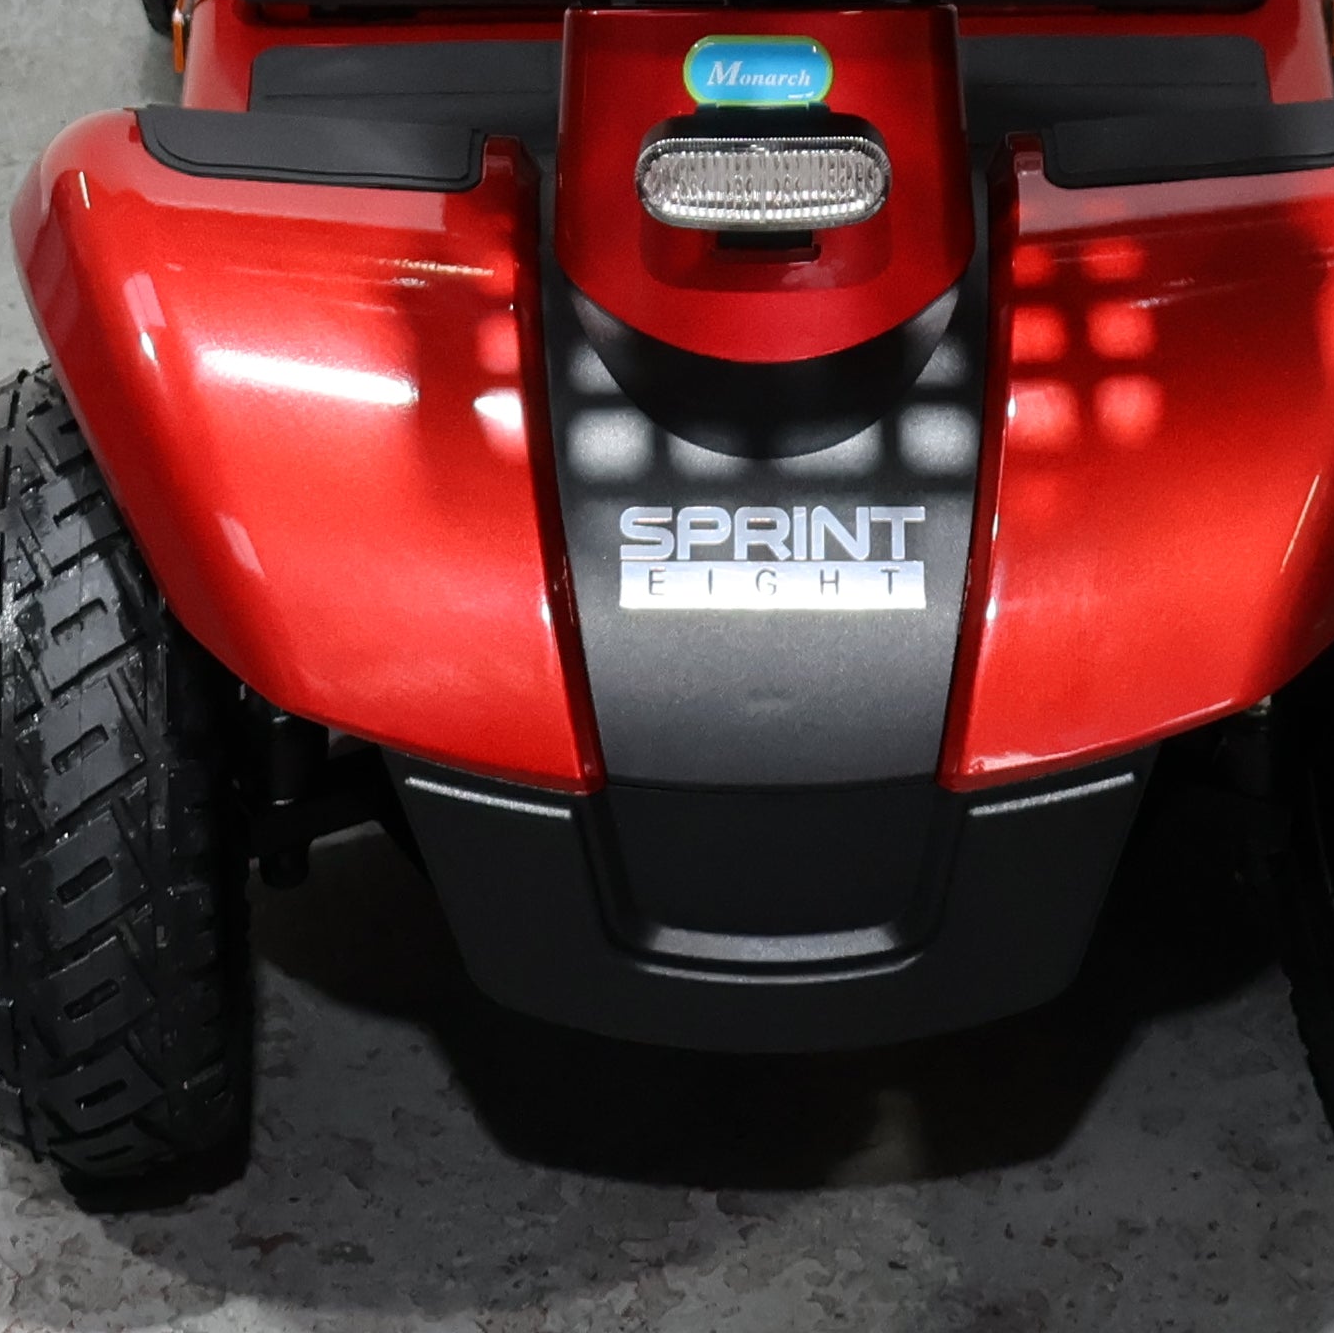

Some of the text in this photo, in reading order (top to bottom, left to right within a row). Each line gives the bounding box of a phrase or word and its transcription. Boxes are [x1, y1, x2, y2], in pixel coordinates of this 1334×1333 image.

[707, 60, 812, 87] Monarch
[619, 505, 926, 561] SPRINT
[647, 568, 901, 596] EIGHT
